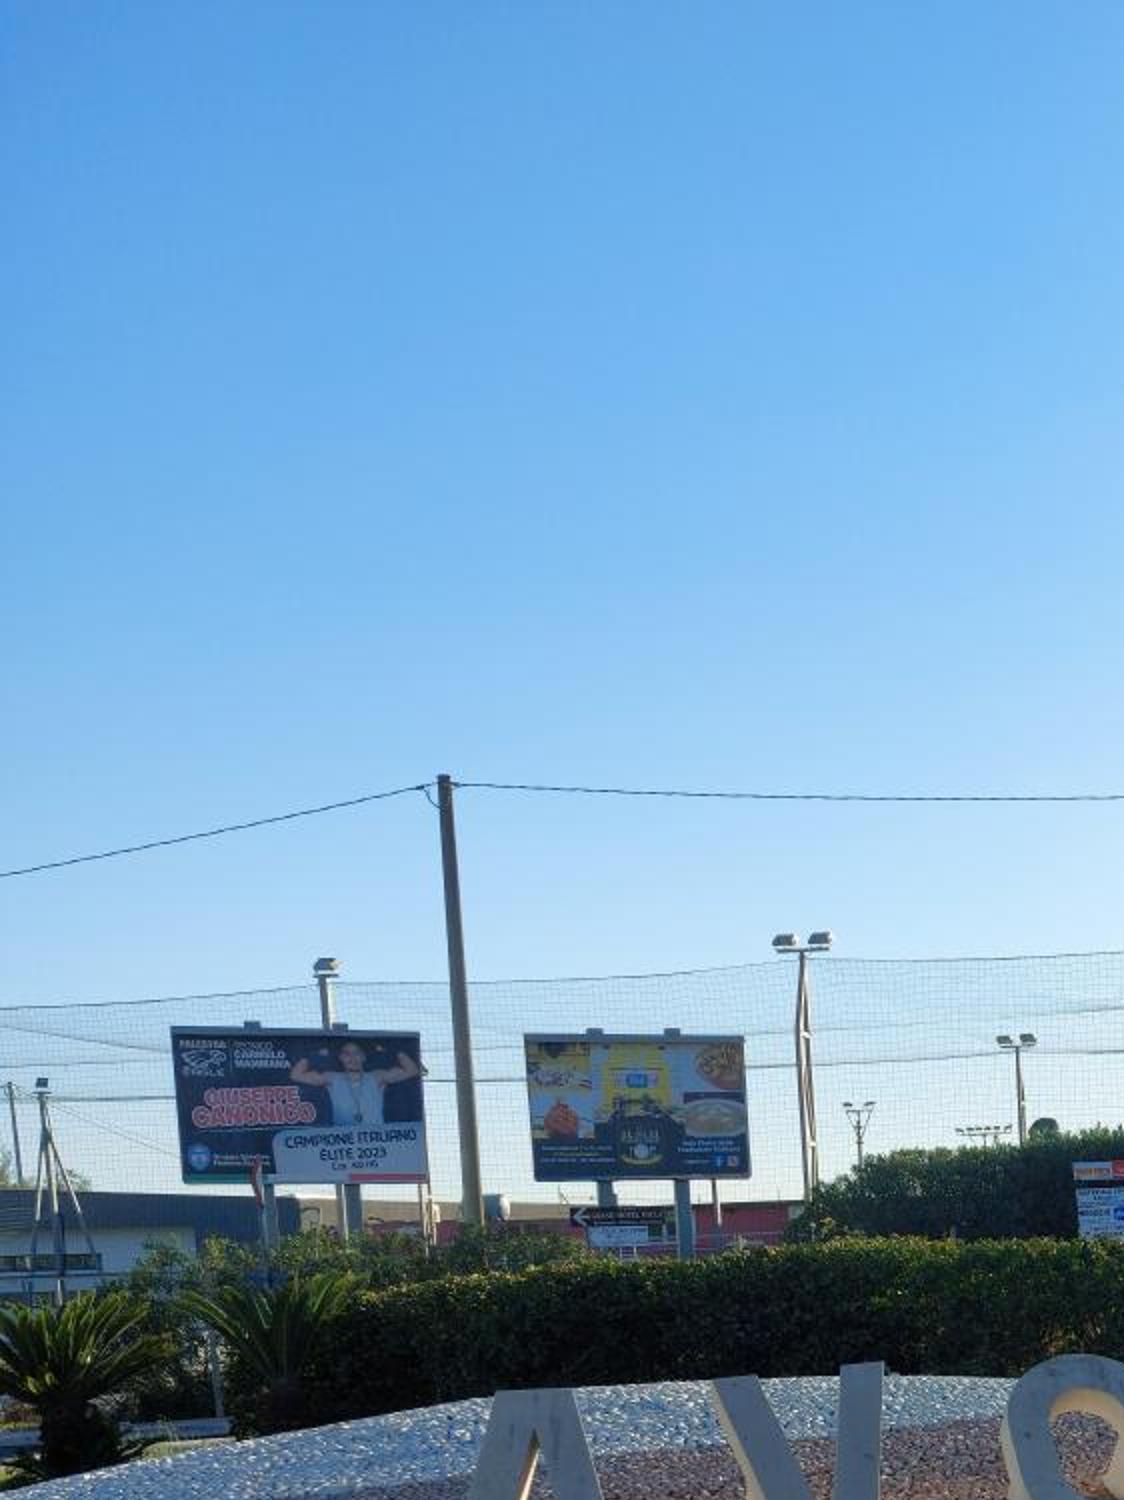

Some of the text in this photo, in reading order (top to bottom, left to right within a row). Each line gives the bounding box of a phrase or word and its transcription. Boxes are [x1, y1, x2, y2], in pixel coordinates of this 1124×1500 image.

[204, 1086, 301, 1106] GIUSEPPE
[192, 1102, 317, 1128] CANONICO
[285, 1127, 417, 1150] CAMPIONE ITALIANO
[319, 1146, 387, 1162] ELITE 2023
